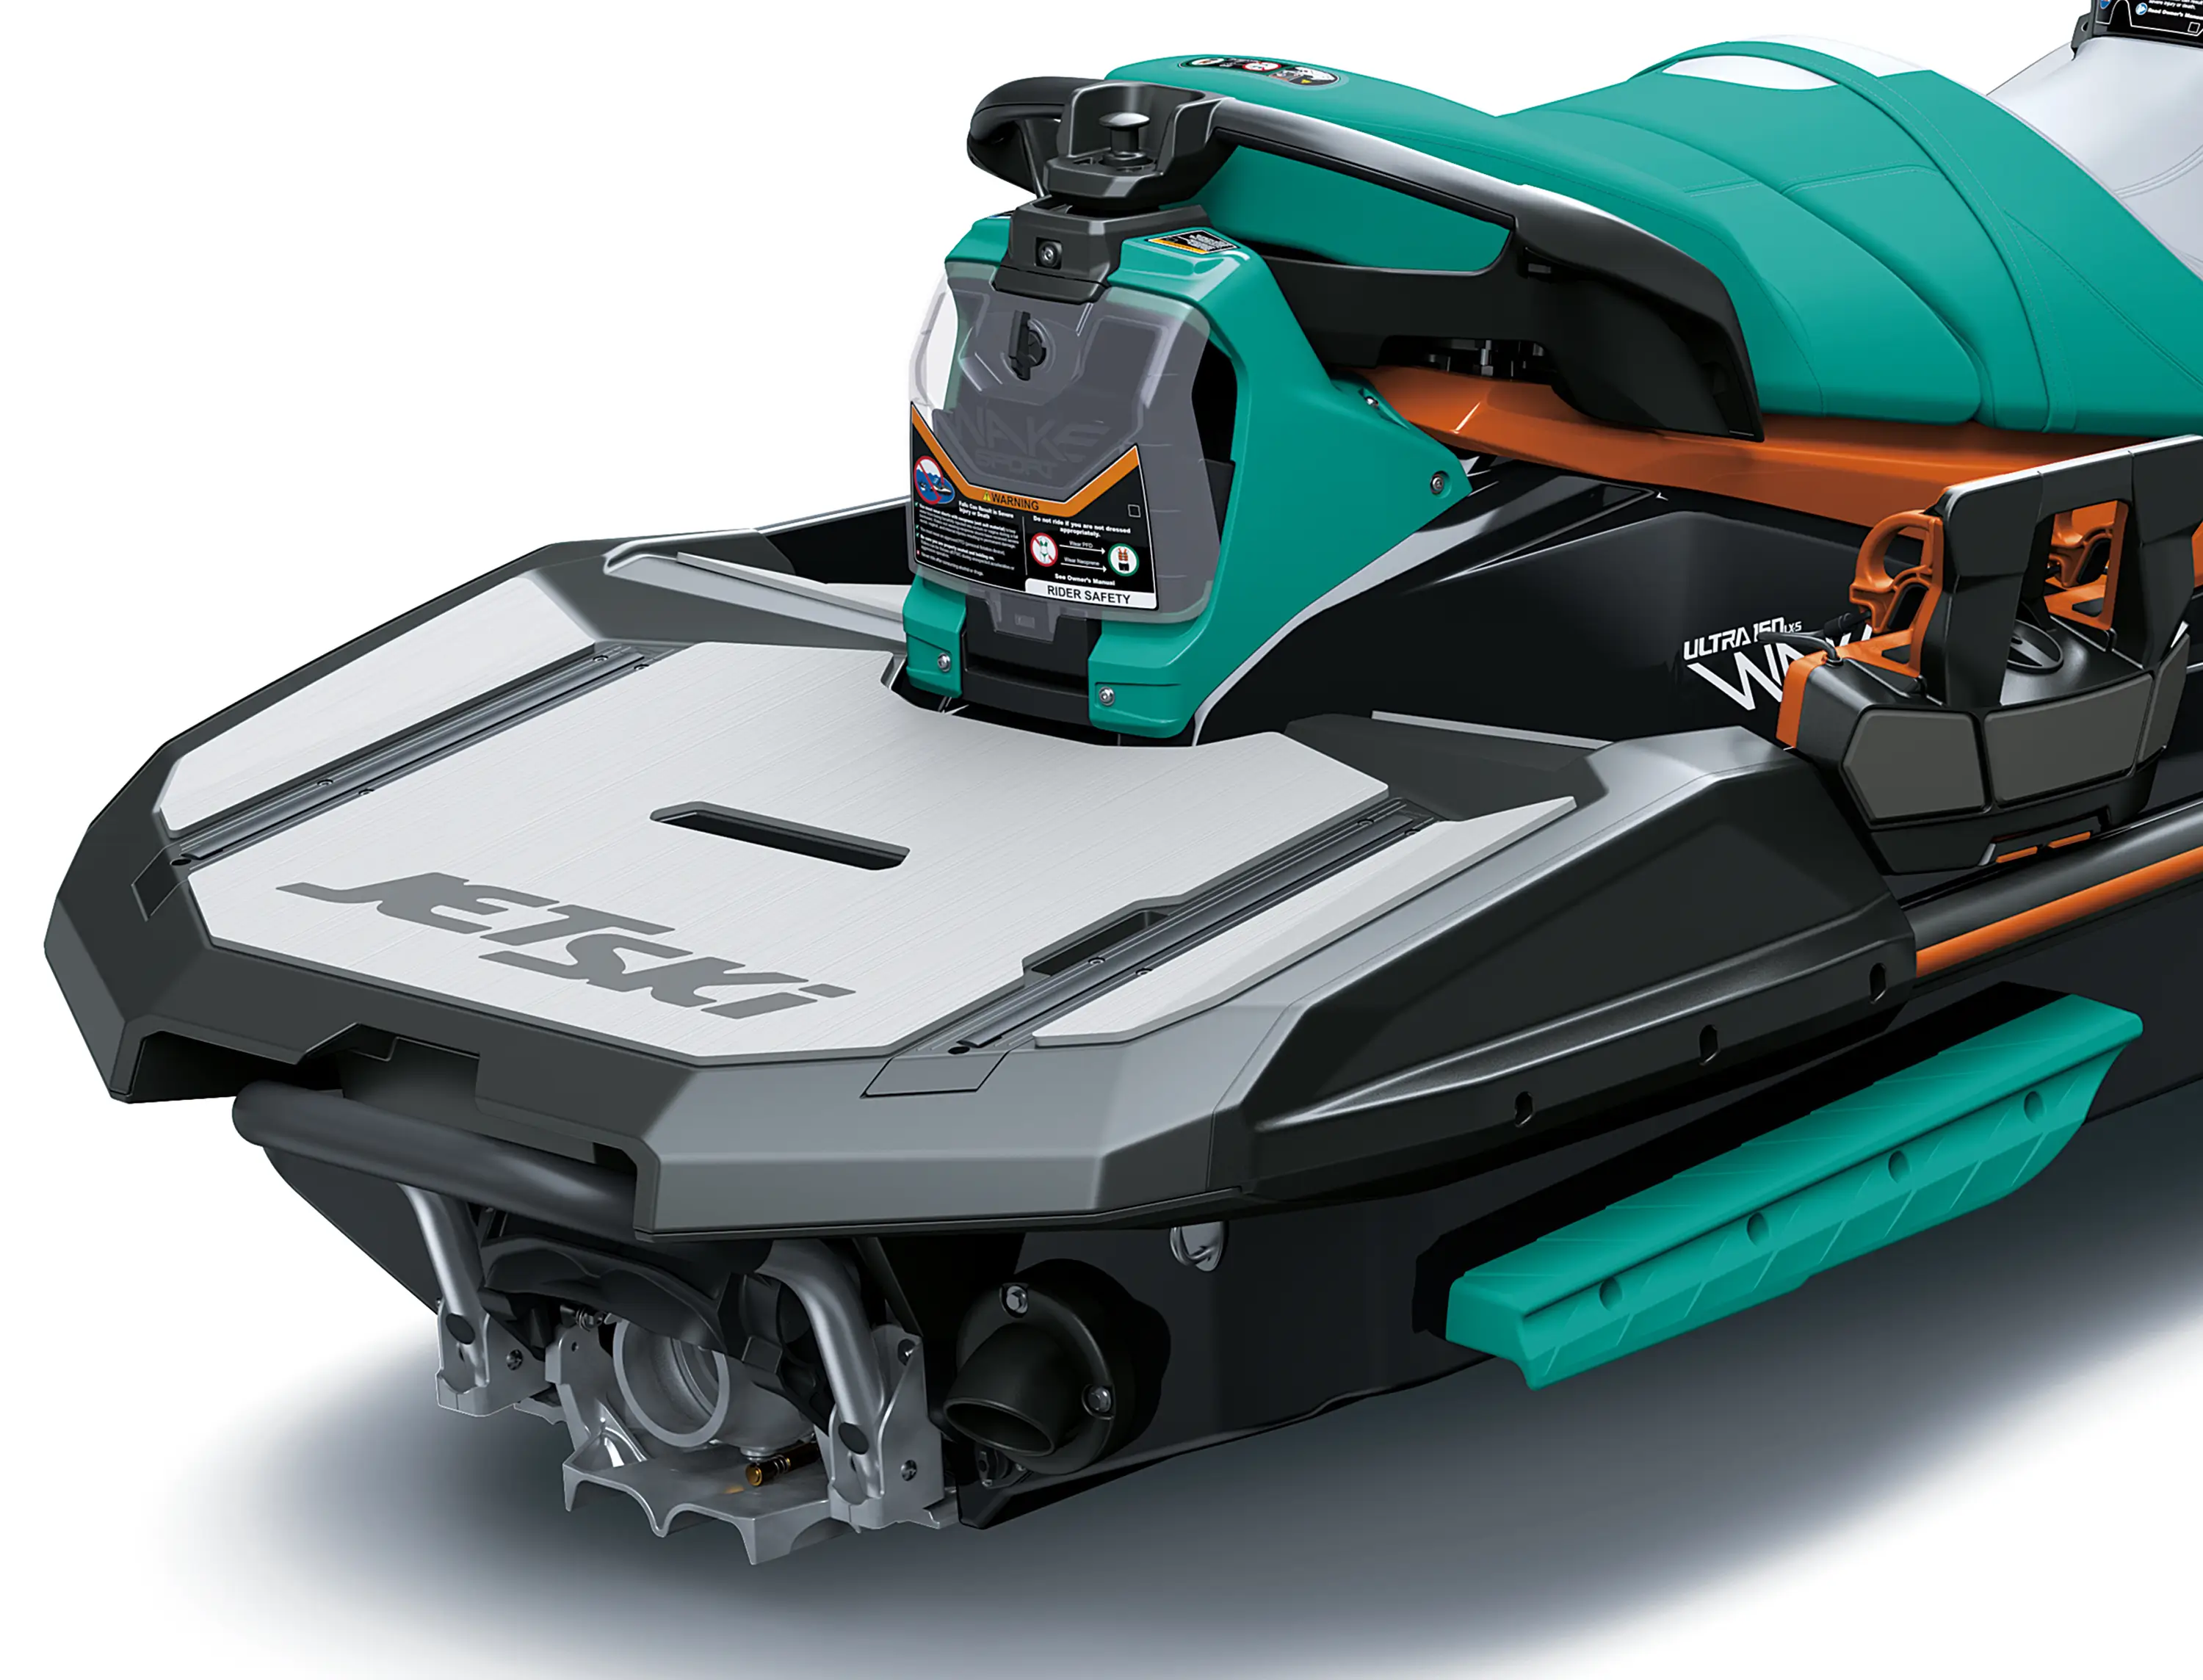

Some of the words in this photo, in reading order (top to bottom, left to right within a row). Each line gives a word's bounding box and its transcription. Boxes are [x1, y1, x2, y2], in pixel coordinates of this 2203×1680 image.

[991, 493, 1039, 511] WARNING
[1052, 518, 1063, 526] ride
[1106, 524, 1131, 534] dressed
[1060, 526, 1101, 538] appropriately.
[1077, 557, 1100, 566] Neoprene
[1067, 574, 1091, 584] Owner's
[1093, 577, 1115, 586] Manual
[1047, 584, 1082, 600] RIDER
[1084, 590, 1131, 604] SAFETY
[1683, 626, 1751, 661] ULTRA
